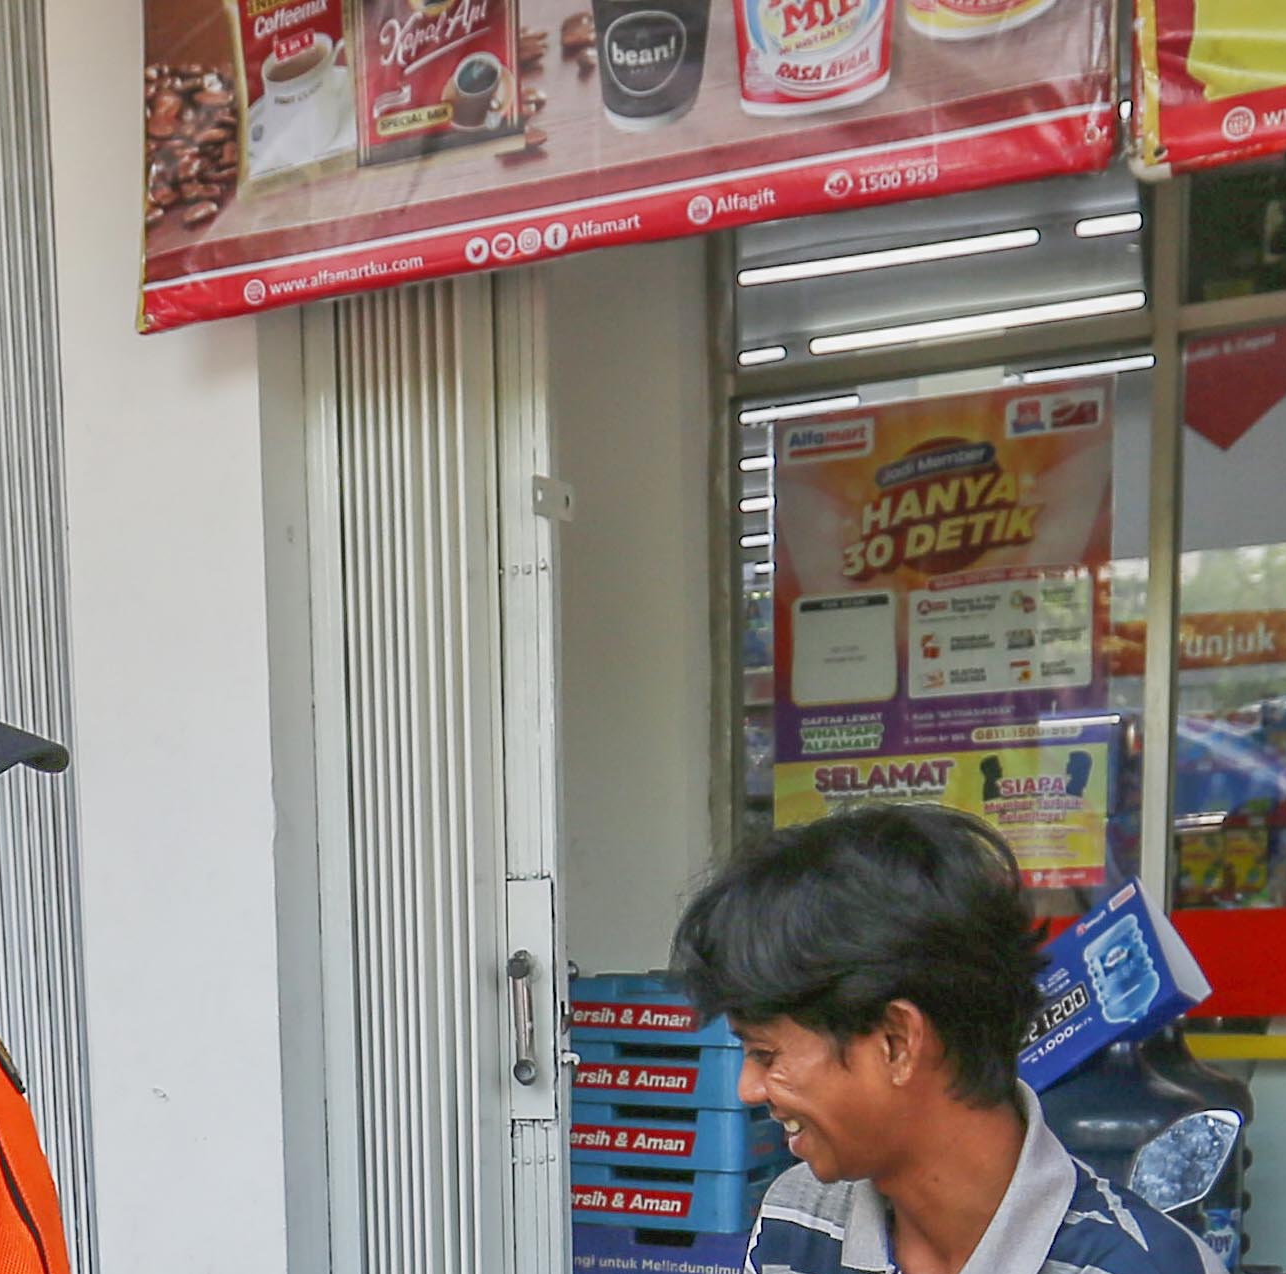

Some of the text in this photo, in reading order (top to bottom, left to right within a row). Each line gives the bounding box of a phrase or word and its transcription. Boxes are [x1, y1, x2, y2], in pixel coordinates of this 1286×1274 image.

[612, 37, 676, 66] bean!
[776, 61, 822, 80] RASA
[859, 164, 939, 193] 1500 959
[716, 187, 776, 215] Alfagift
[572, 213, 641, 243] Alfamart
[270, 253, 424, 297] www.alfamartku.com
[789, 426, 867, 448] Alfamart
[917, 447, 986, 470] Member
[862, 473, 1016, 534] HANYA
[842, 505, 1041, 577] 30 DETIK
[802, 724, 885, 740] WHATSAPP
[815, 759, 954, 792] SELAMAT
[1001, 777, 1067, 798] SIAPA
[571, 1007, 692, 1028] ersih & Aman
[616, 1070, 630, 1085] &
[635, 1071, 688, 1088] Aman
[570, 1131, 686, 1151] ersih & Aman
[611, 1193, 625, 1208] &
[629, 1194, 682, 1212] Aman
[574, 1256, 595, 1270] ngi
[599, 1256, 638, 1270] untuk
